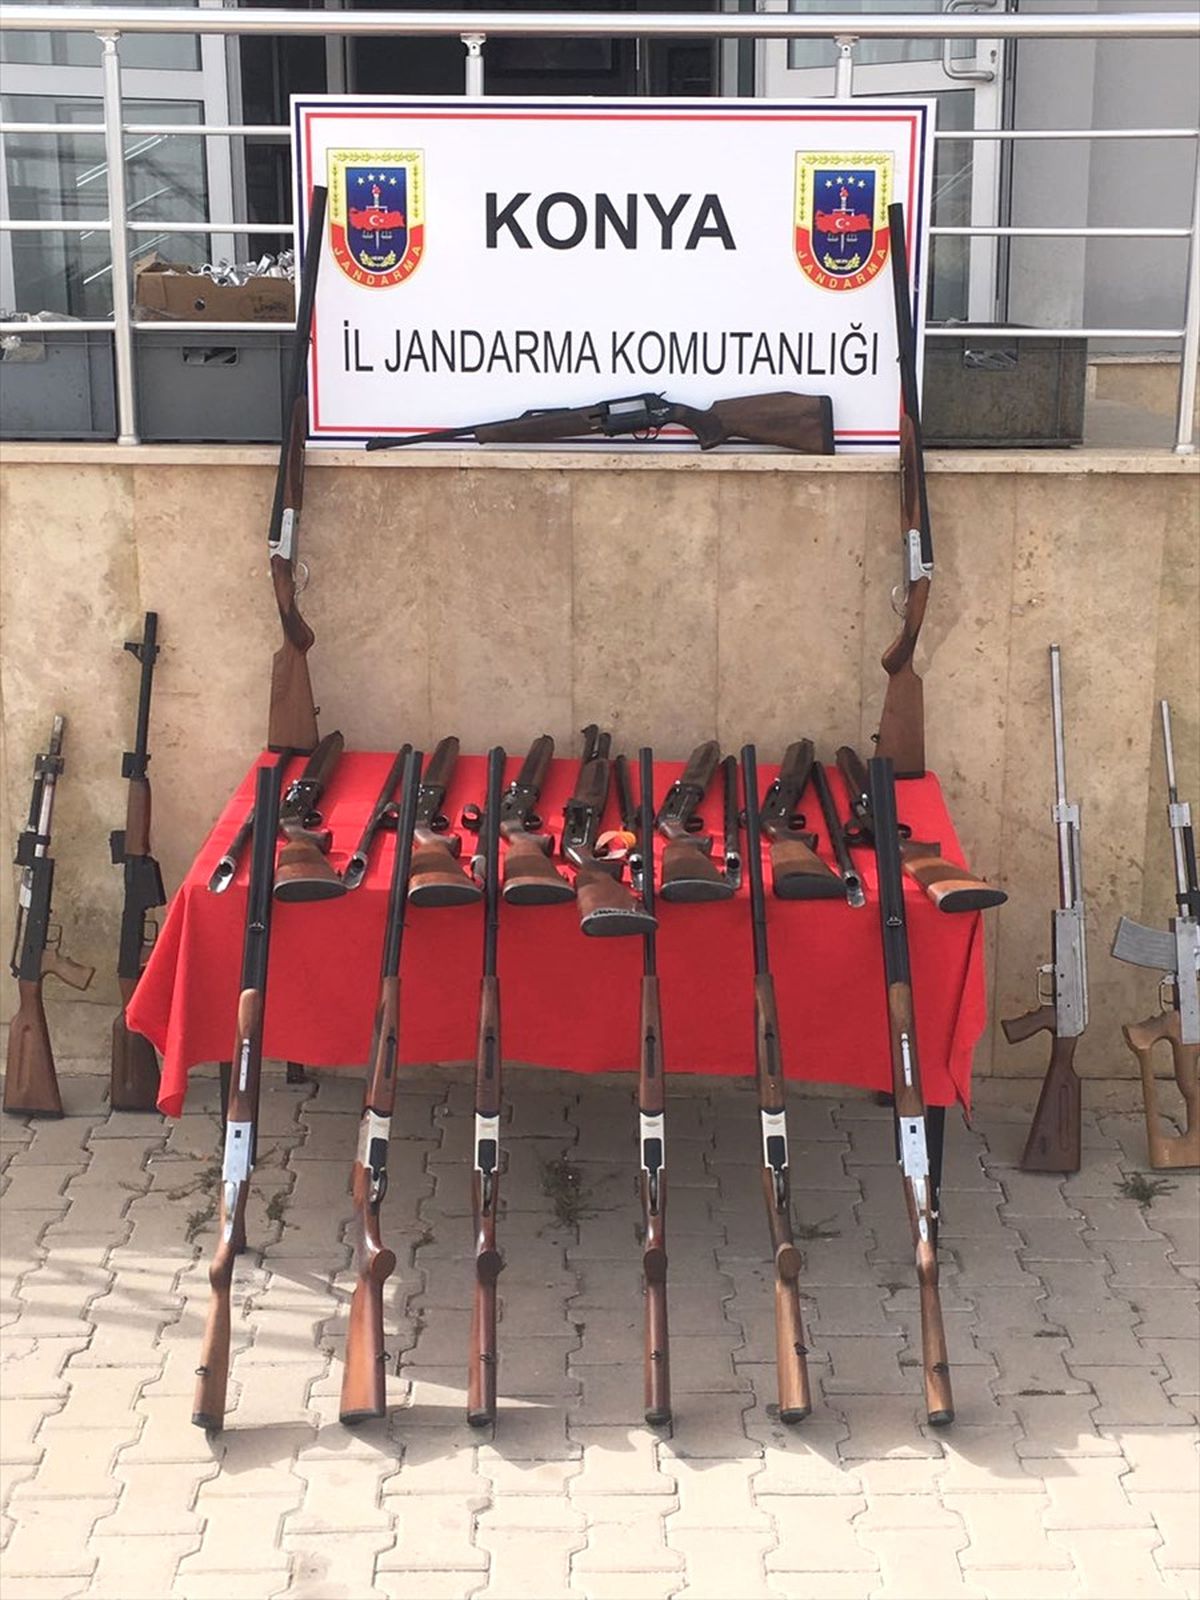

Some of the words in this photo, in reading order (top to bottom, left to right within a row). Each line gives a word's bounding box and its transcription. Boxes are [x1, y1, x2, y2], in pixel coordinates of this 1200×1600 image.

[486, 193, 736, 249] KONYA
[334, 245, 421, 285] JANDARMA
[798, 248, 886, 288] JANDARMA
[344, 320, 373, 372] İL
[385, 330, 600, 373] JANDARMA
[613, 323, 878, 375] KOMUTANLIĞI
